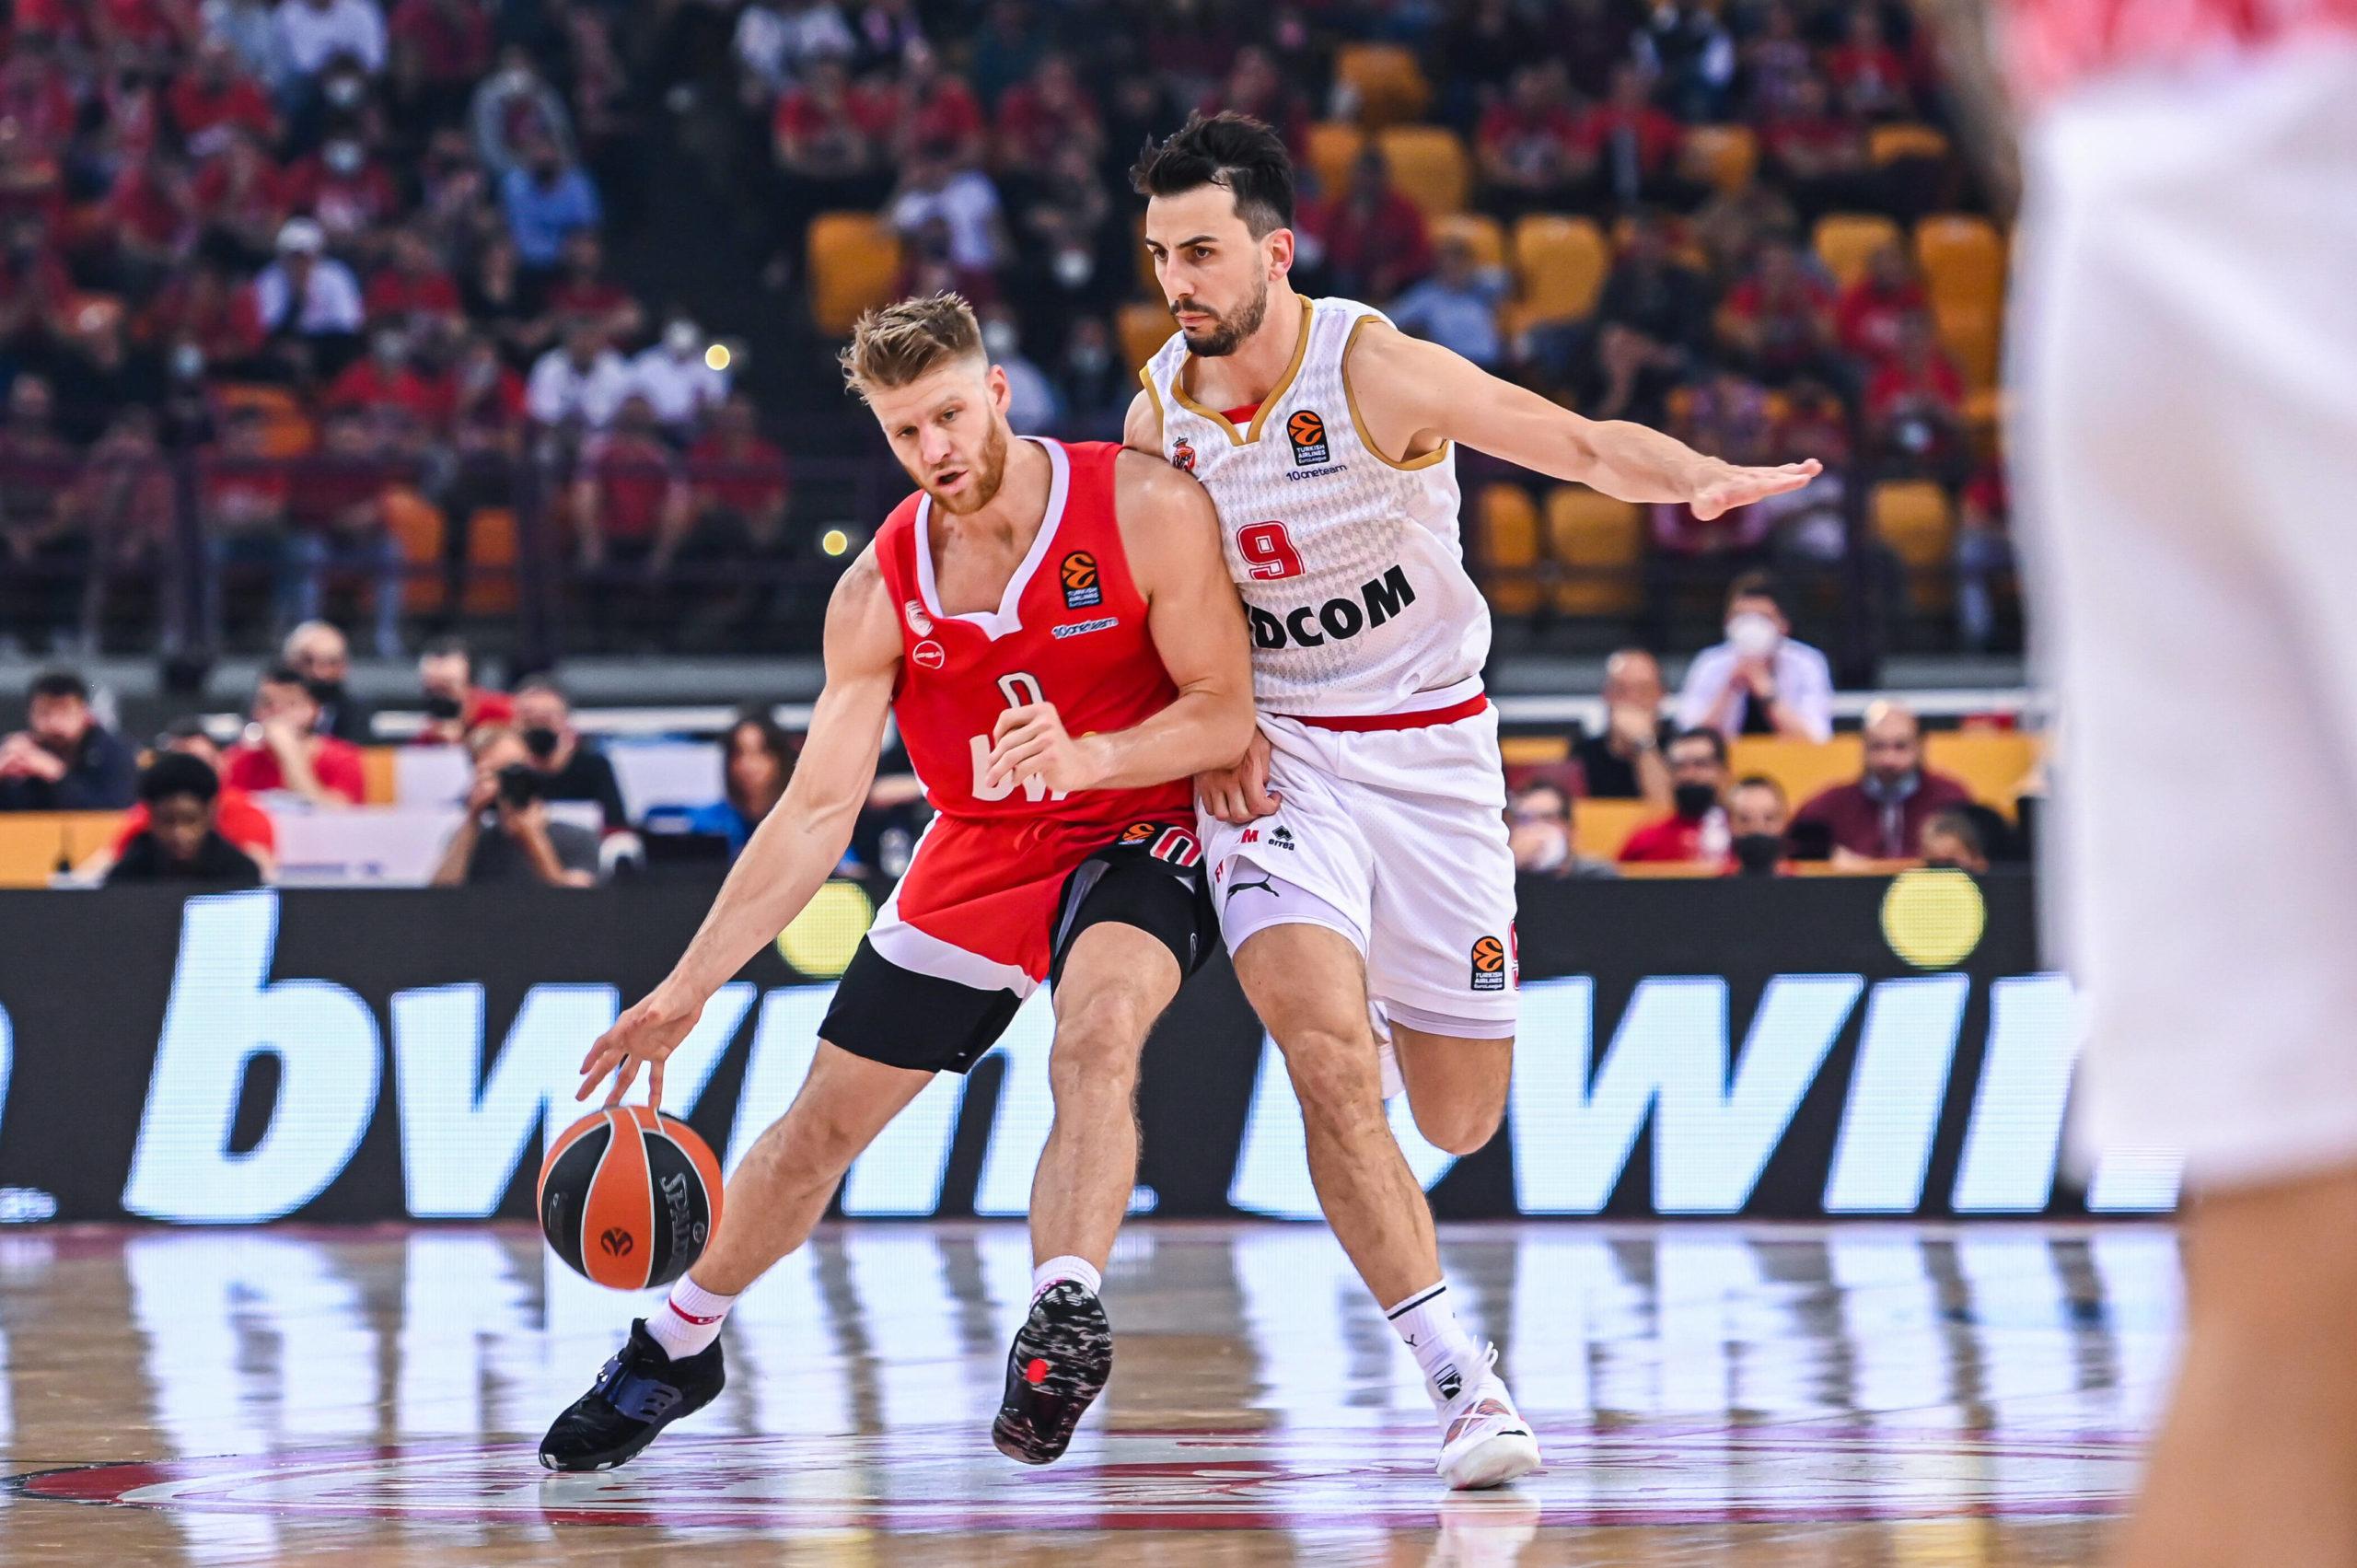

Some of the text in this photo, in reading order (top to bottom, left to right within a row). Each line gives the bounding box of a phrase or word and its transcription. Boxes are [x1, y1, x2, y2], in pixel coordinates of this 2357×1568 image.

[1296, 444, 1325, 453] TURKISH
[1298, 449, 1327, 459] AIRLINES
[1237, 520, 1306, 581] 9
[1243, 564, 1416, 649] DCOM
[121, 879, 1057, 1223] bwin
